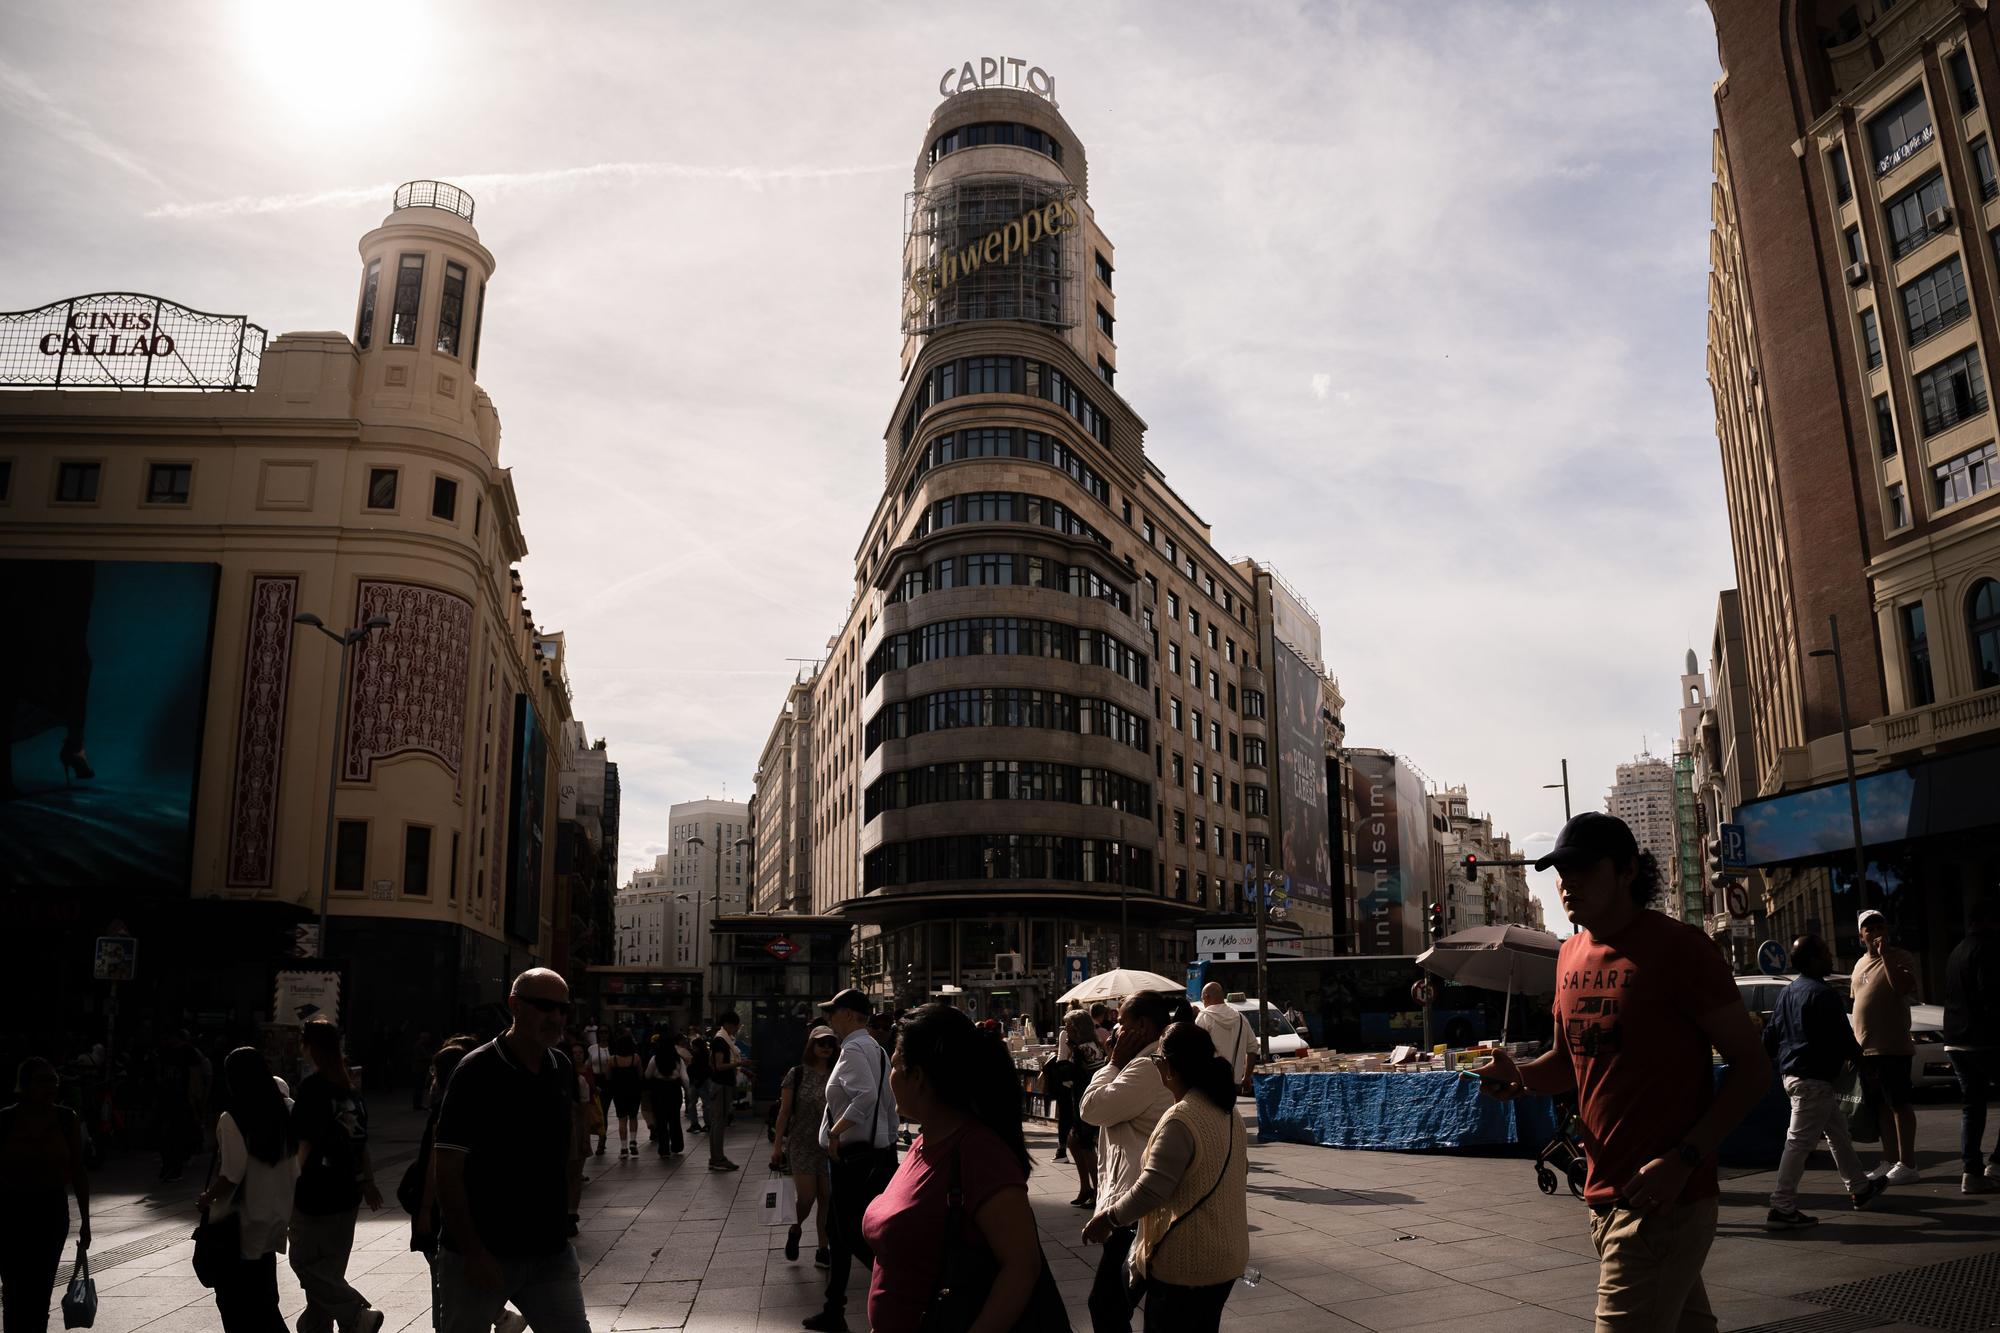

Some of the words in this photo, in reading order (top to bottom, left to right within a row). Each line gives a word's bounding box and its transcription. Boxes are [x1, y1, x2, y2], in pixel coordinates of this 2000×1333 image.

[940, 56, 1060, 109] CAPITOL
[910, 187, 1080, 318] Schweppes
[70, 311, 152, 330] CINES
[40, 333, 175, 357] CALLAO
[1370, 774, 1390, 946] intimissimi
[1728, 831, 1742, 861] P
[1563, 968, 1635, 990] SAFARI
